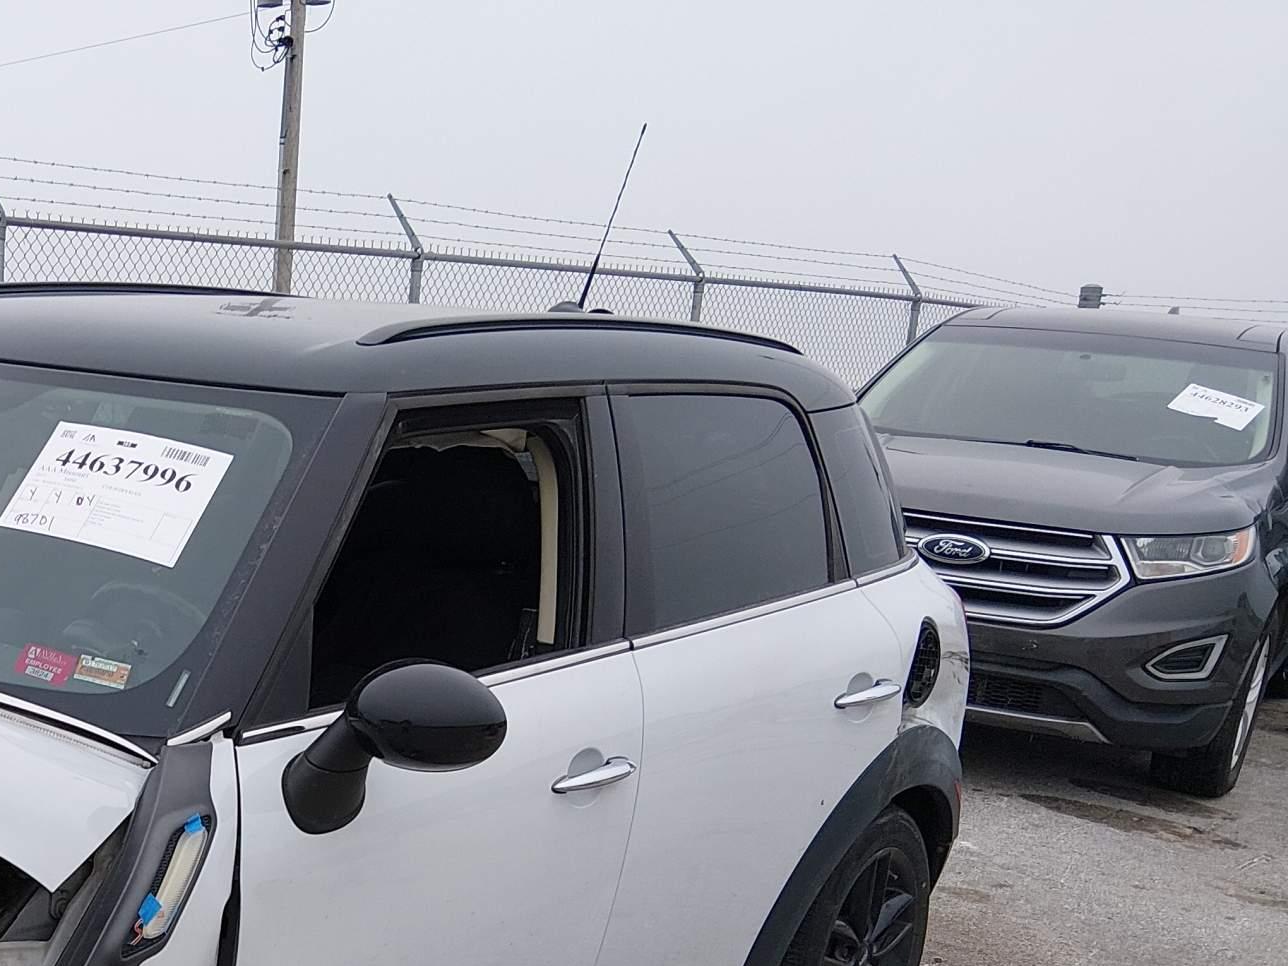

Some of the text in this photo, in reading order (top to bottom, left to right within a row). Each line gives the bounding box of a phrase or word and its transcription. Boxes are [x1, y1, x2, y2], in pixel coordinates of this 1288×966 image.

[55, 447, 200, 494] 44637996
[934, 539, 972, 557] Ford
[24, 657, 63, 675] EMPLOYEE
